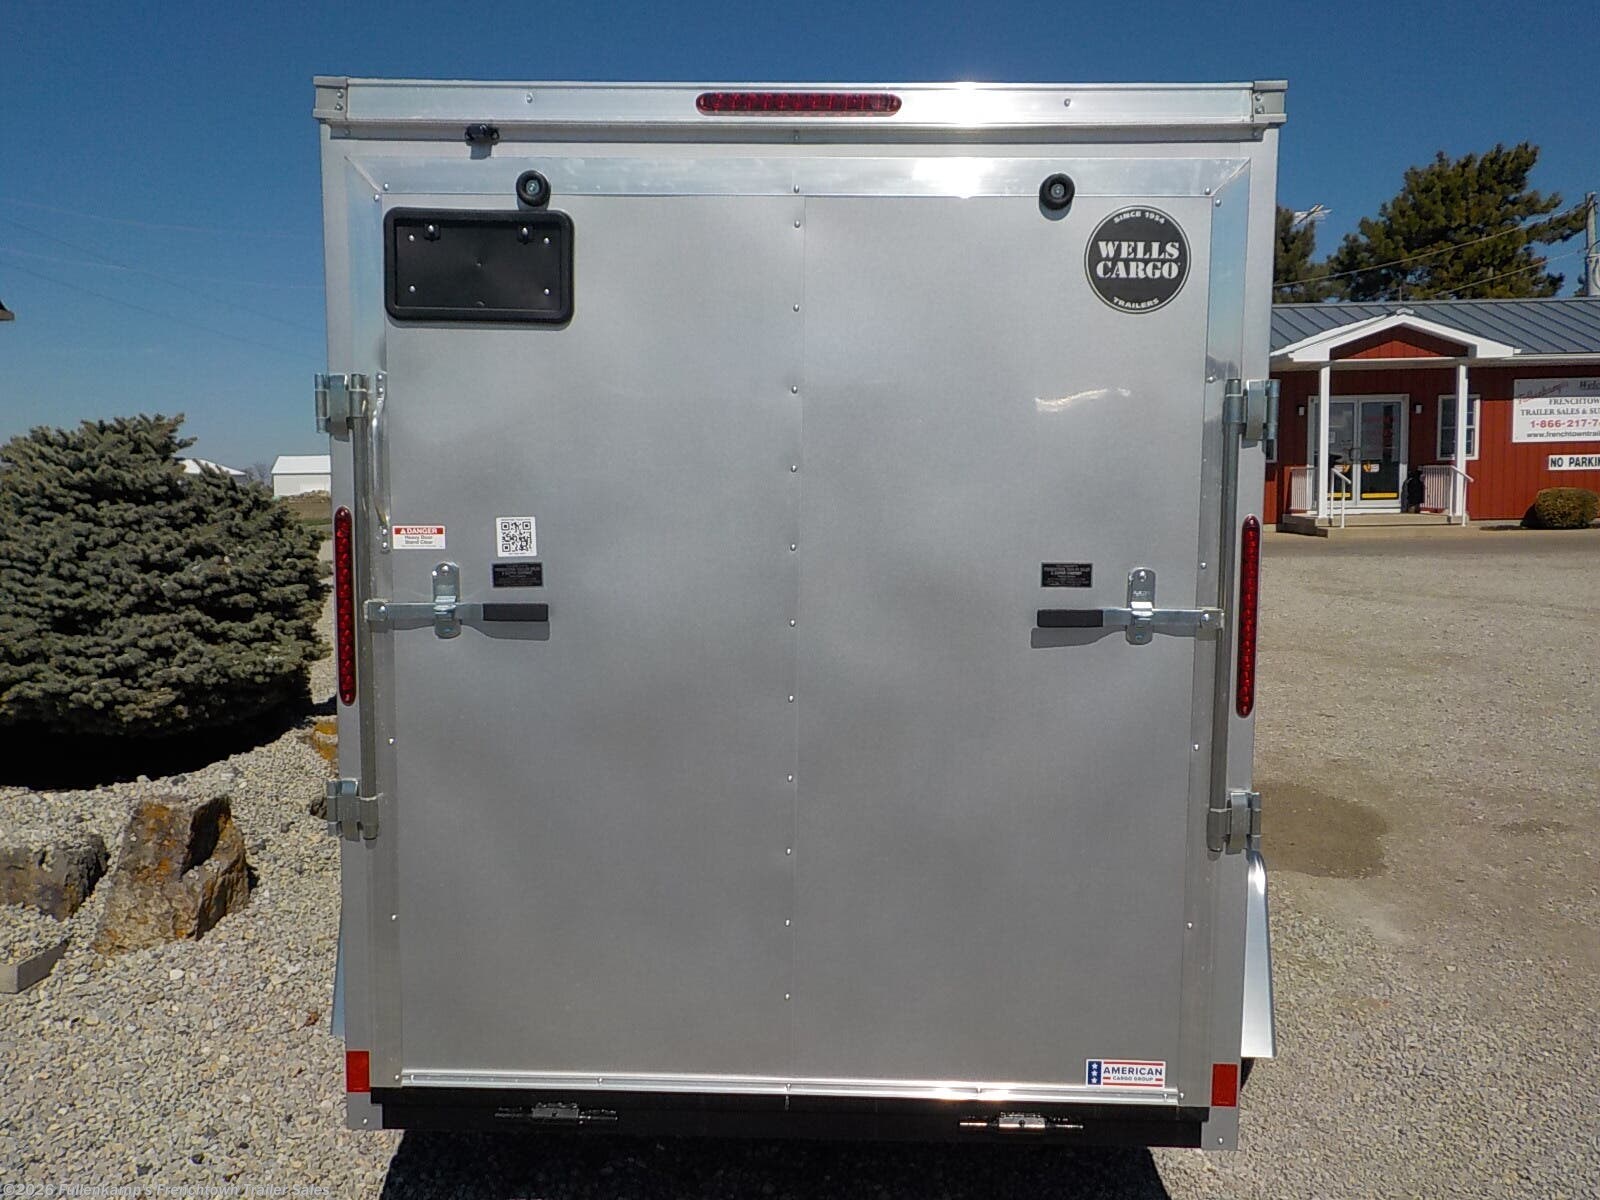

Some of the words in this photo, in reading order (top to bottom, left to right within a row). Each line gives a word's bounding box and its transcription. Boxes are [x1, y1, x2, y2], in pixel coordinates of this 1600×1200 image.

[1113, 211, 1142, 224] SINCE
[1097, 241, 1180, 260] WELLS
[1095, 260, 1180, 279] CARGO
[1113, 296, 1160, 309] TRAILERS
[1556, 407, 1580, 415] SALES
[1531, 419, 1600, 428] 1-866-217-7
[1550, 457, 1564, 467] NO
[1103, 1066, 1163, 1076] AMERICAN
